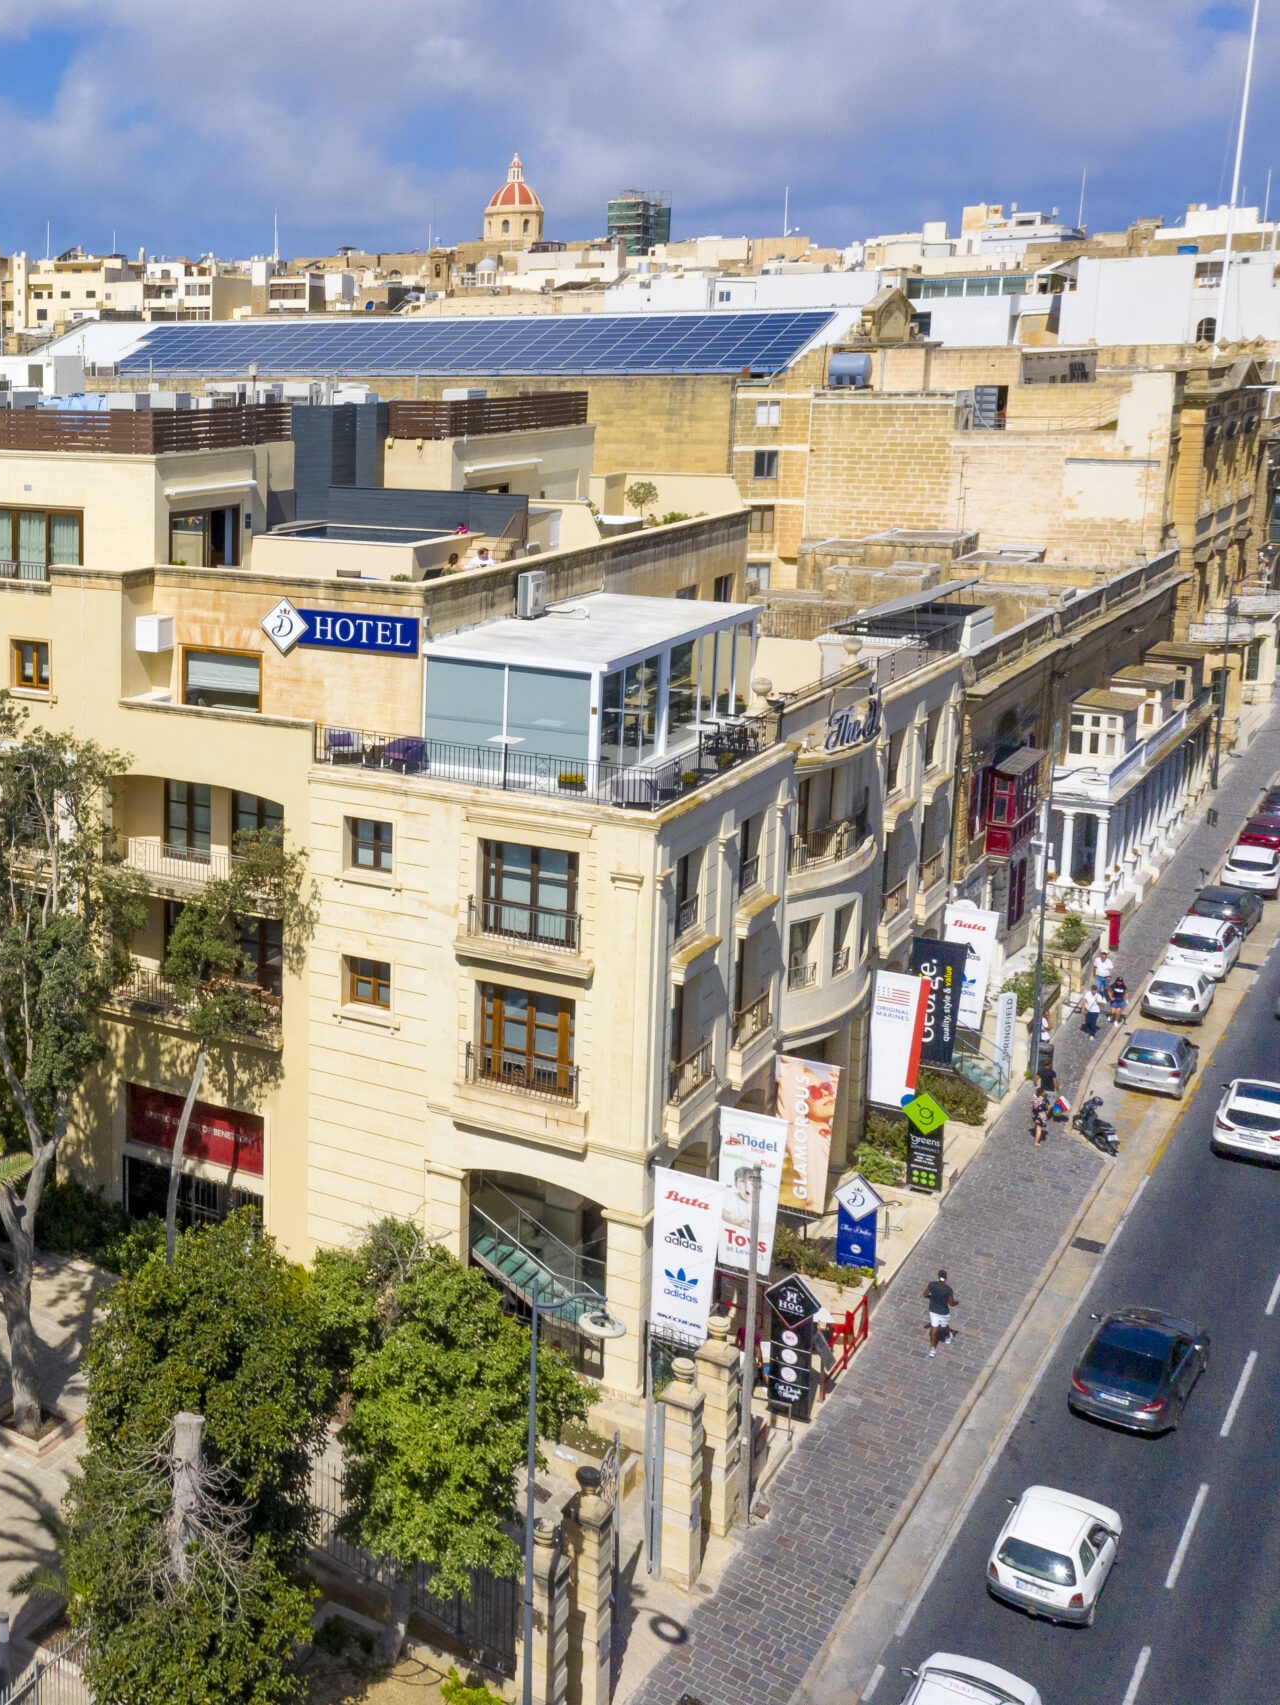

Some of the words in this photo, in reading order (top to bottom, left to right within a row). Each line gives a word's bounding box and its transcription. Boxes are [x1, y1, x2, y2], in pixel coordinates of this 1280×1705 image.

[313, 616, 412, 647] HOTEL
[952, 919, 987, 932] Bata
[943, 965, 953, 987] value
[876, 1005, 910, 1016] ORIGINAL
[943, 995, 953, 1014] style
[876, 1011, 910, 1022] MARINES
[942, 1013, 952, 1042] quality,
[1001, 998, 1014, 1063] SPRINGFIELD
[793, 1074, 811, 1200] GLAMOROUS
[665, 1190, 710, 1210] Bata
[664, 1235, 703, 1253] adidas
[663, 1288, 698, 1304] adidas
